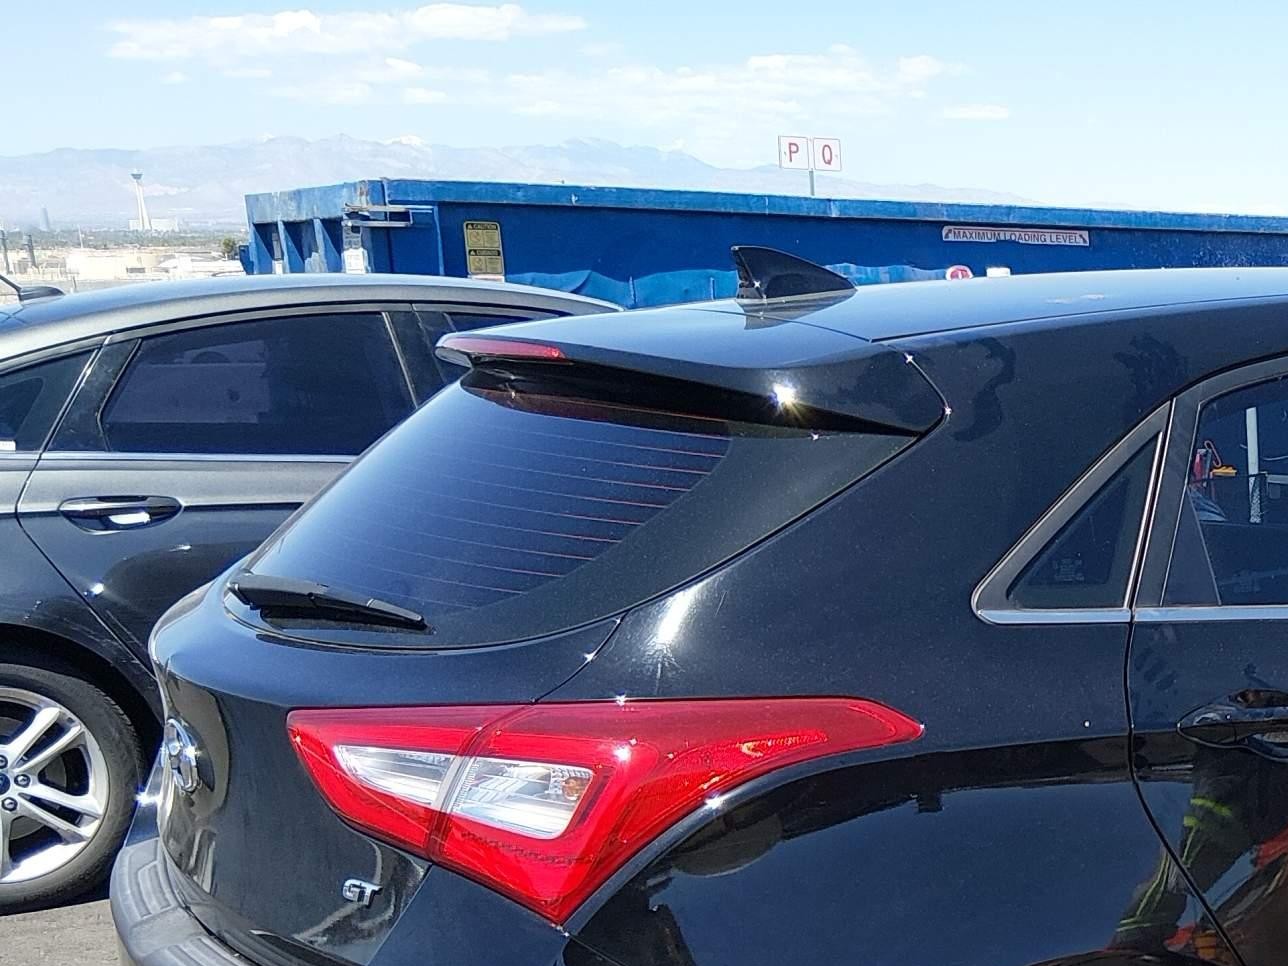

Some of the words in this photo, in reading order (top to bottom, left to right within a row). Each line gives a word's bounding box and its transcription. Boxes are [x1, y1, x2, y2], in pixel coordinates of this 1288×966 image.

[788, 142, 799, 163] P
[822, 144, 833, 165] Q
[953, 230, 1000, 241] MAXIMUM
[1050, 234, 1080, 244] LEVEL
[343, 879, 382, 906] GT
